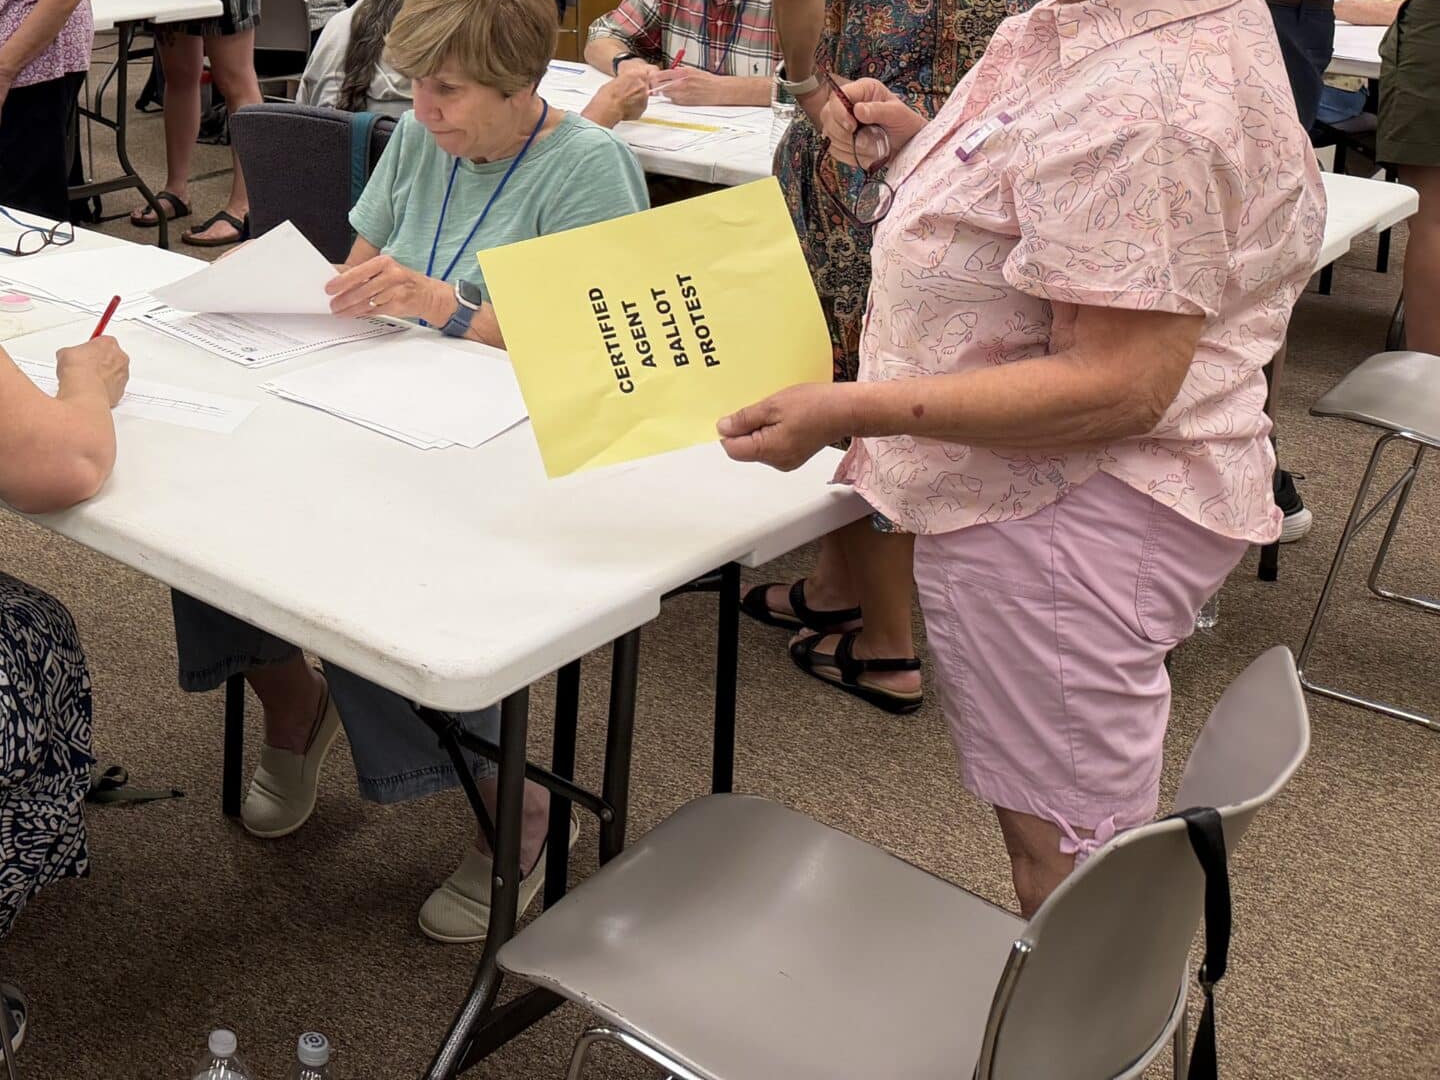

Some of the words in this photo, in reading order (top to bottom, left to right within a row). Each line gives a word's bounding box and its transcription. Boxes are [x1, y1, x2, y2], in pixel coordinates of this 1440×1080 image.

[588, 287, 634, 394] CERTIFIED
[621, 300, 657, 368] AGENT
[650, 287, 690, 367] BALLOT
[676, 274, 721, 368] PROTEST
